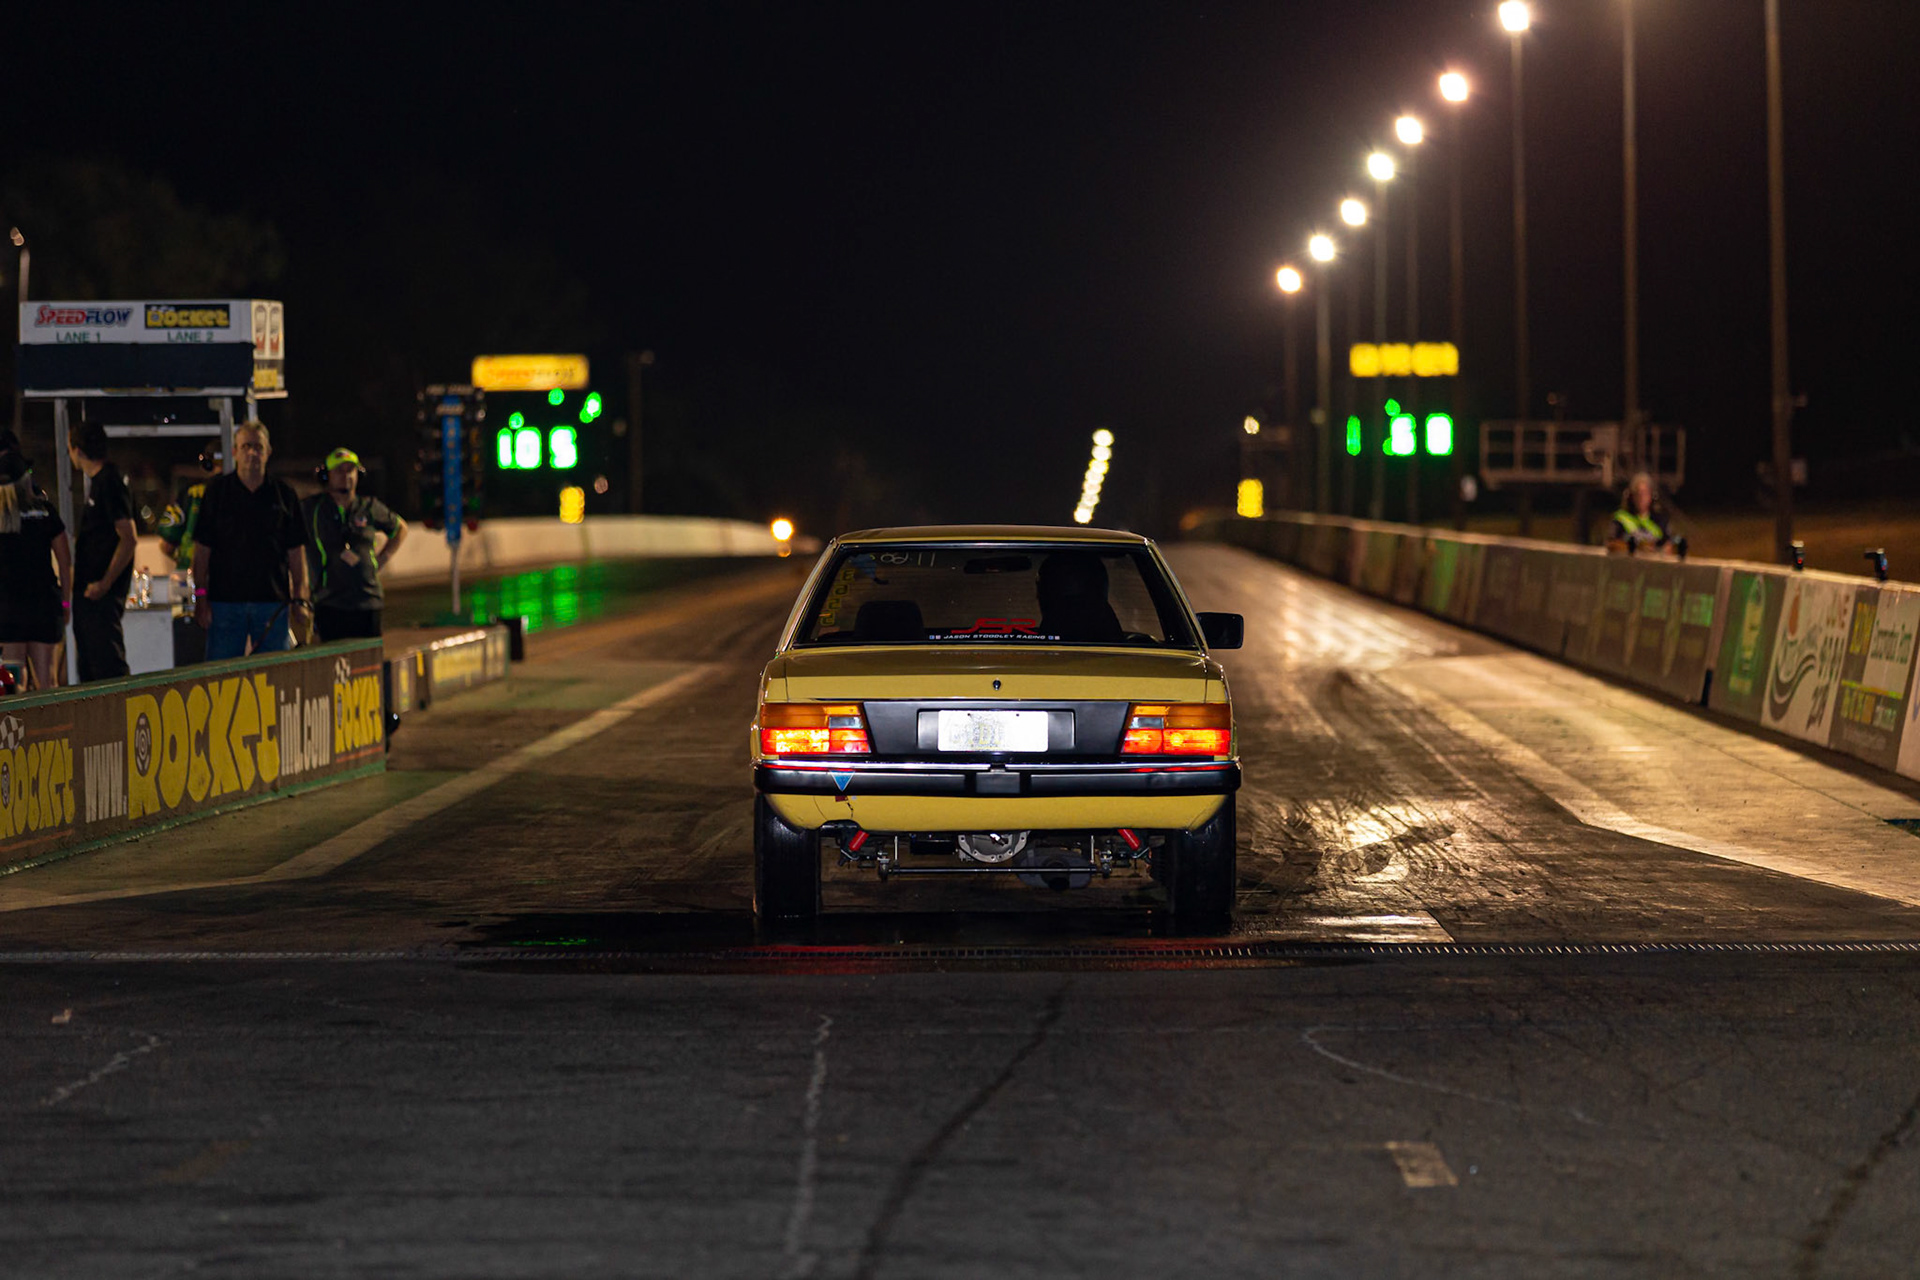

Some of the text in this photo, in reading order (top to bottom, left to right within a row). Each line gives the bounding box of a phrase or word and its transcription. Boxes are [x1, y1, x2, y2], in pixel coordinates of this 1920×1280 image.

[55, 332, 101, 343] LANE 1
[167, 331, 214, 342] LANE 2
[950, 617, 1038, 635] JSR
